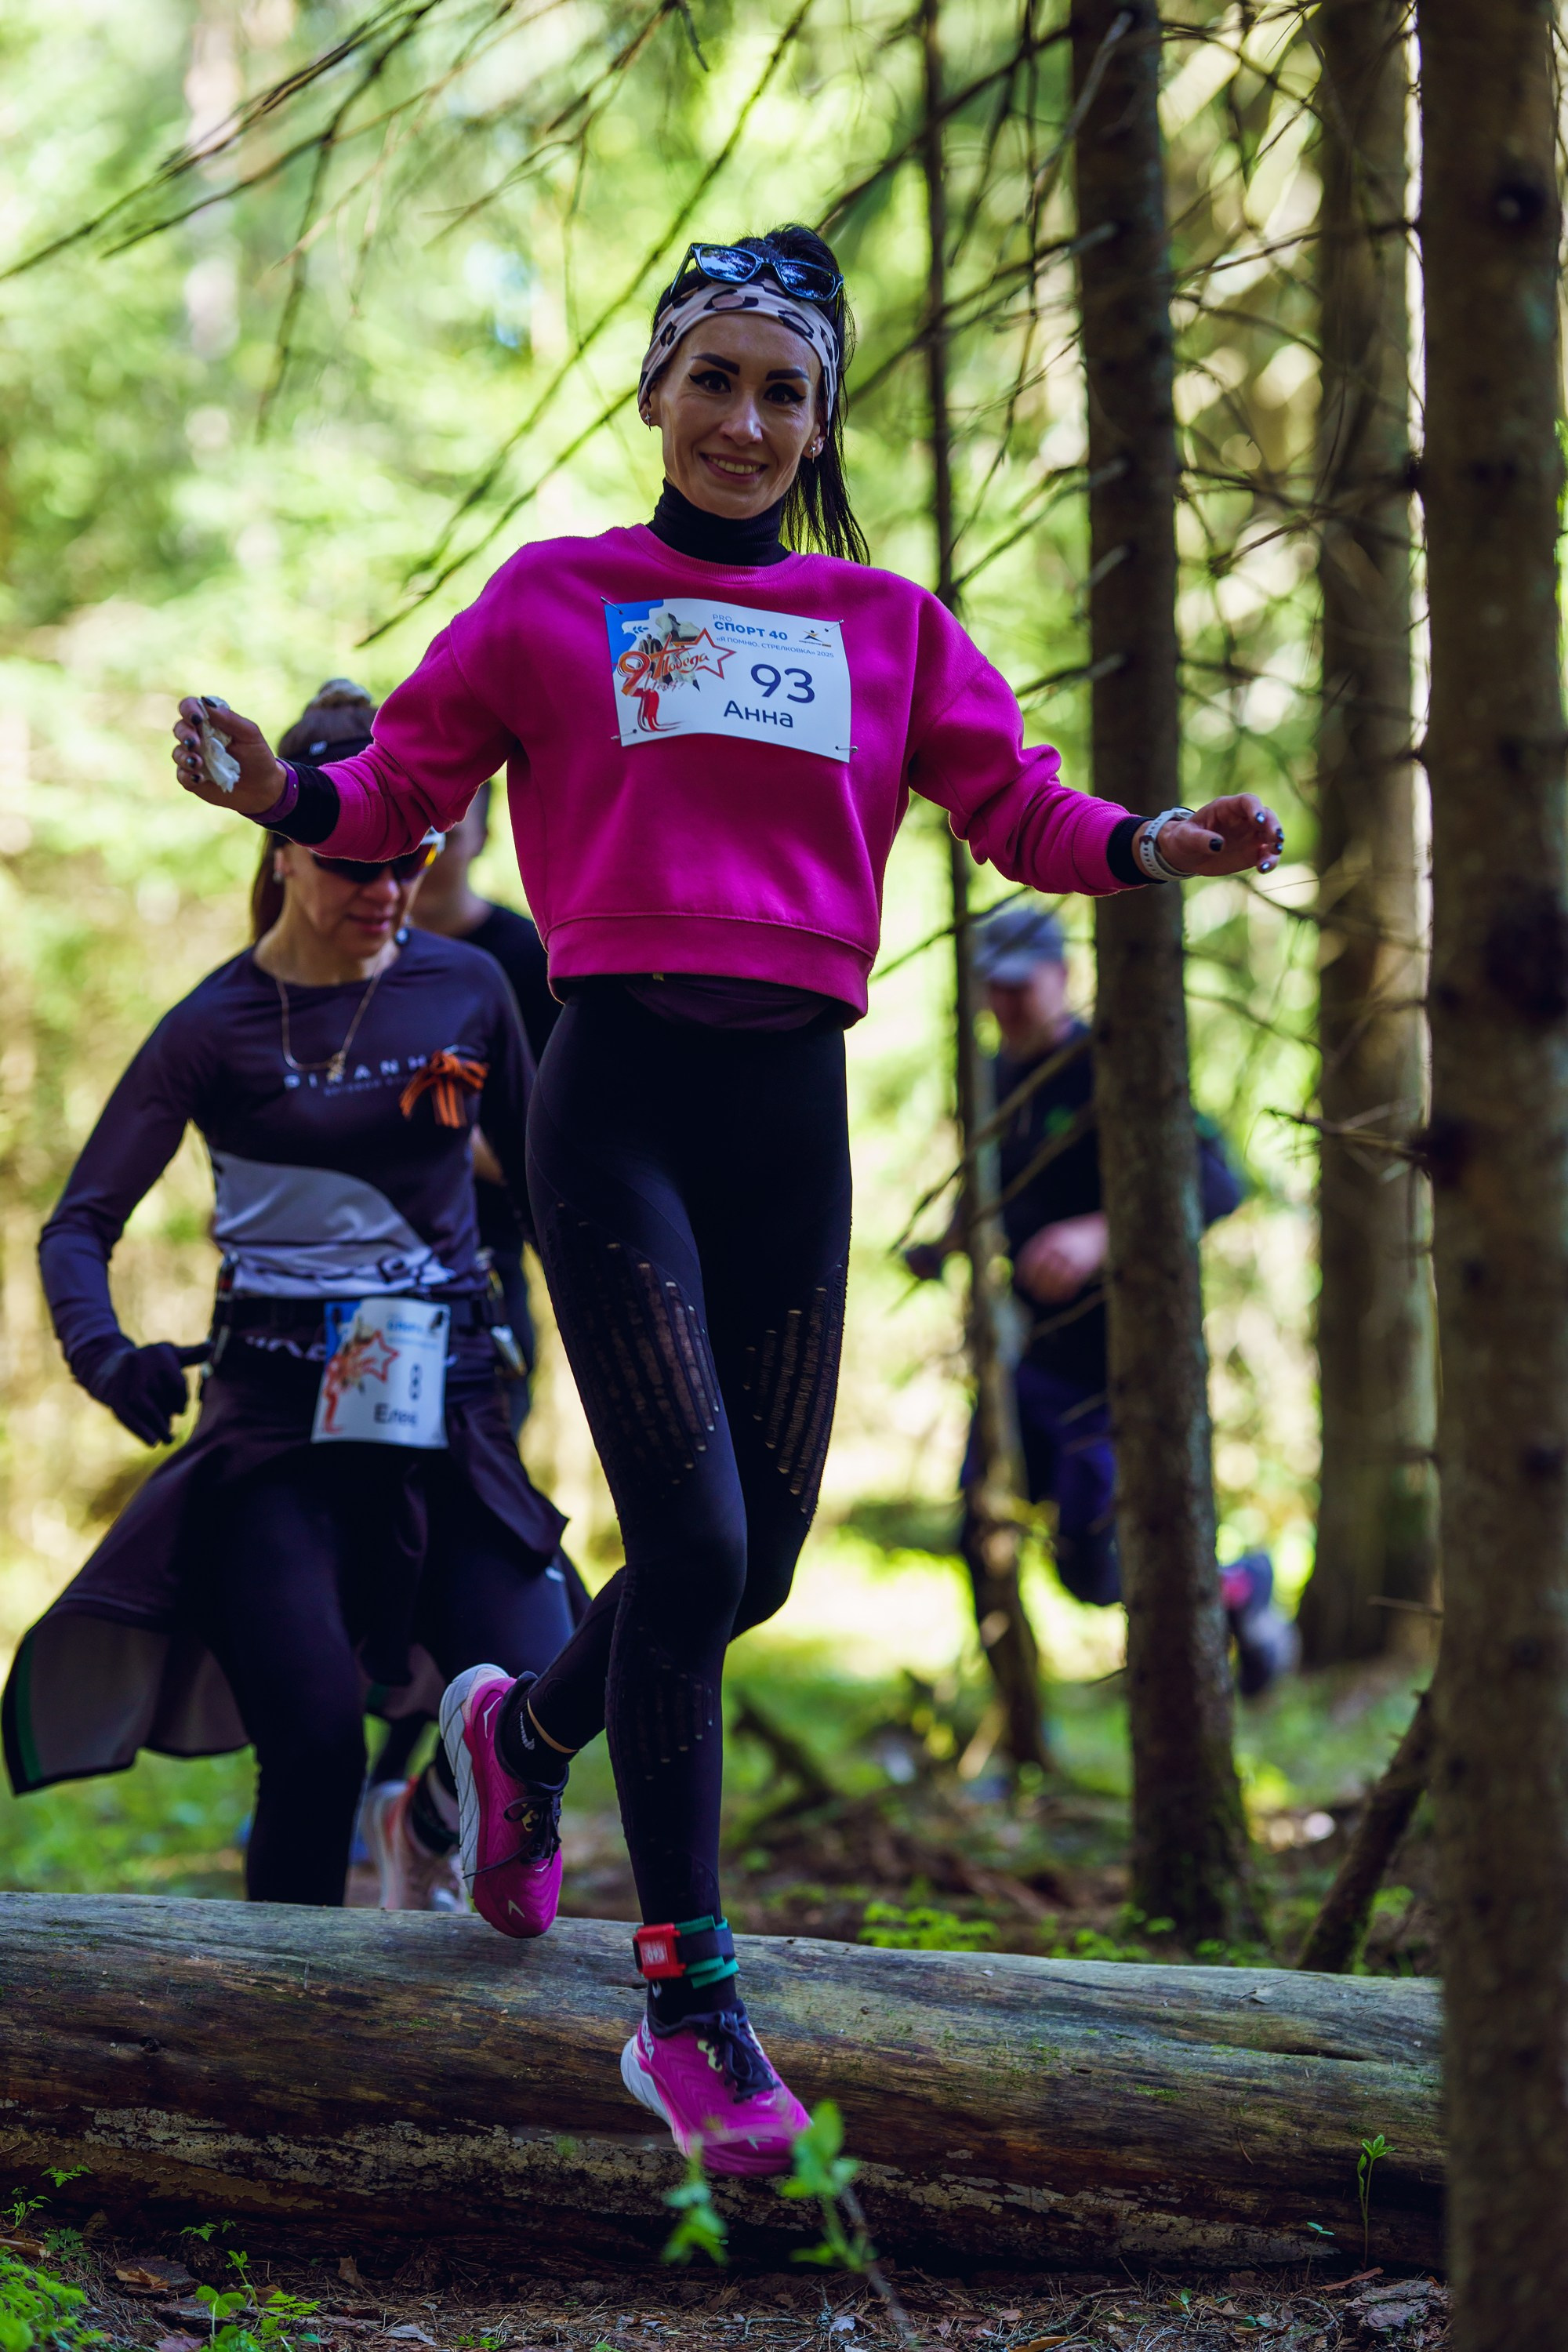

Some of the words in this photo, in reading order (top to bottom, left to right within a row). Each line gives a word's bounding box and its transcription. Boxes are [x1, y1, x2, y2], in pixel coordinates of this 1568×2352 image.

[714, 621, 765, 637] СПОРТ
[768, 630, 788, 641] 40
[727, 637, 760, 648] ПОМНЮ.
[761, 642, 815, 655] СТРЕЛКОВКА»
[750, 663, 815, 704] 93
[723, 700, 793, 728] Анна
